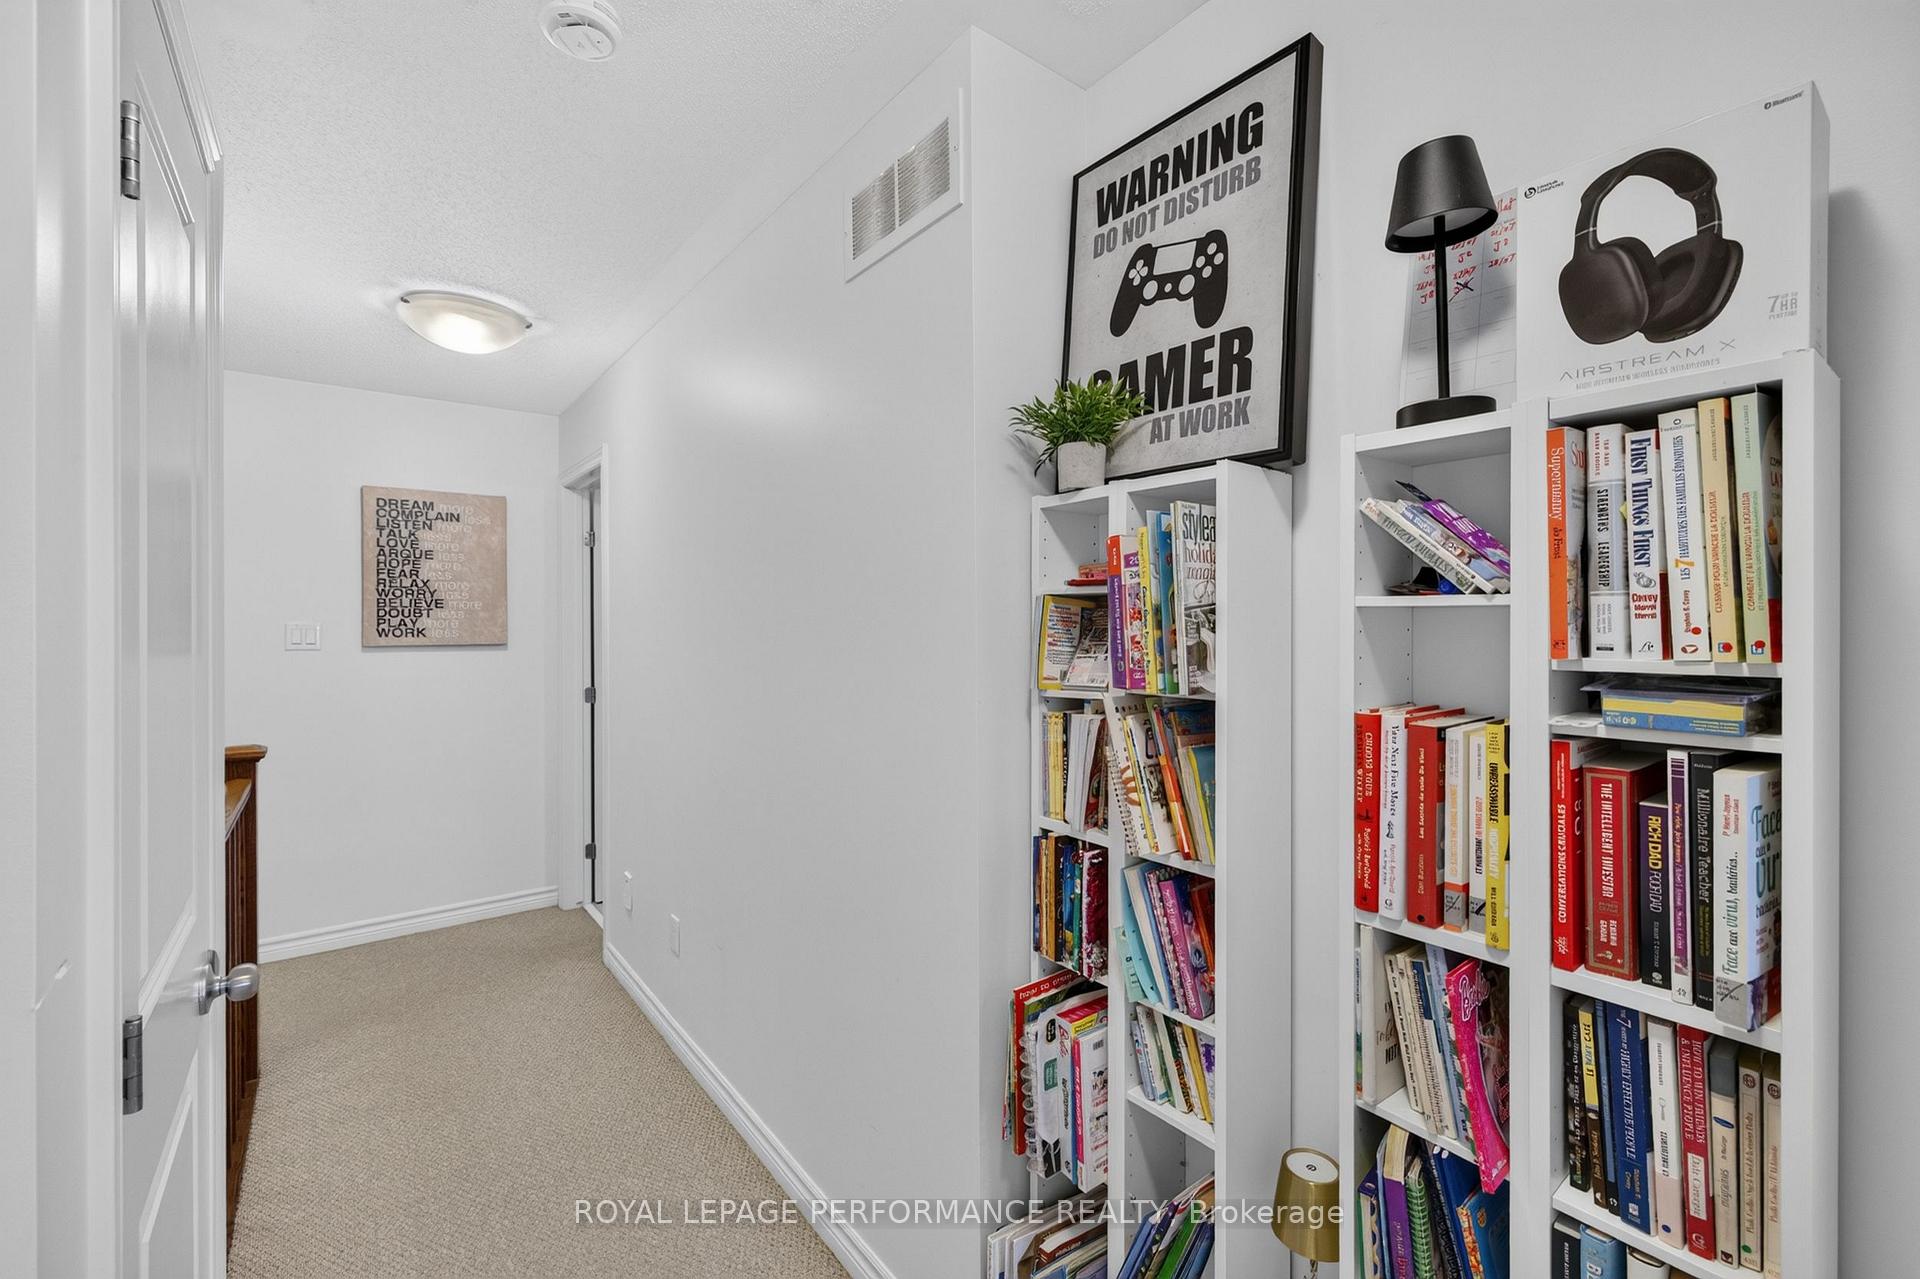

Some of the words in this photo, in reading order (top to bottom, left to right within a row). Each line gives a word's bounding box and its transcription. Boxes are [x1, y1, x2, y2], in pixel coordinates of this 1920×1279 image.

[1096, 101, 1264, 228] WARNING
[1093, 223, 1117, 260] DO
[1121, 204, 1160, 247] NOT
[1163, 155, 1262, 227] DISTURB
[1093, 326, 1254, 415] AMER
[1560, 344, 1705, 381] AIRSTREAM
[1719, 338, 1736, 351] X
[1150, 416, 1175, 445] AT
[1179, 395, 1251, 438] WORK
[1630, 437, 1652, 475] FIRST
[1548, 447, 1564, 520] Supernanny
[1675, 473, 1688, 505] FAMILLES
[376, 498, 434, 511] DREAM
[1631, 478, 1653, 527] THINGS
[1676, 505, 1688, 519] DES
[376, 509, 460, 522] COMPLAIN
[376, 519, 433, 531] LISTEN
[376, 528, 418, 540] TALK
[376, 538, 419, 549] LOVE
[376, 549, 434, 560] ARGUE
[1632, 529, 1655, 568] FIRST
[376, 559, 421, 569] HOPE
[376, 569, 419, 578] FEAR
[1597, 541, 1610, 588] LEADERSHIP
[1675, 558, 1695, 569] 7
[1679, 568, 1690, 581] LES
[376, 579, 430, 589] RELAX
[376, 588, 437, 598] WORRY
[376, 598, 444, 608] BELIEVE
[376, 608, 433, 618] DOUBT
[376, 618, 418, 628] PLAY
[376, 627, 426, 638] WORK
[1390, 746, 1400, 767] Next
[1489, 762, 1499, 824] UNREASONABLE
[1601, 783, 1612, 799] THE
[1557, 804, 1566, 850] CRUCIALES
[1601, 801, 1613, 855] INTELLIGENT
[1648, 815, 1662, 841] RICH
[1697, 788, 1711, 853] Millionaire
[1648, 842, 1662, 870] DAD
[1558, 850, 1567, 923] CONVERSATIONS
[1601, 856, 1614, 898] INVESTOR
[1649, 870, 1662, 894] POOR
[1699, 856, 1712, 904] Teacher
[1650, 893, 1662, 913] DAD
[1721, 947, 1739, 976] Face
[1616, 1018, 1632, 1029] 7
[1681, 1037, 1689, 1045] &
[1692, 1041, 1703, 1065] HOW
[1681, 1047, 1693, 1103] INFLUENCE
[1693, 1066, 1703, 1080] TO
[1693, 1081, 1704, 1100] WIN
[1683, 1103, 1695, 1141] PEOPLE
[1694, 1102, 1706, 1144] FRIENDS
